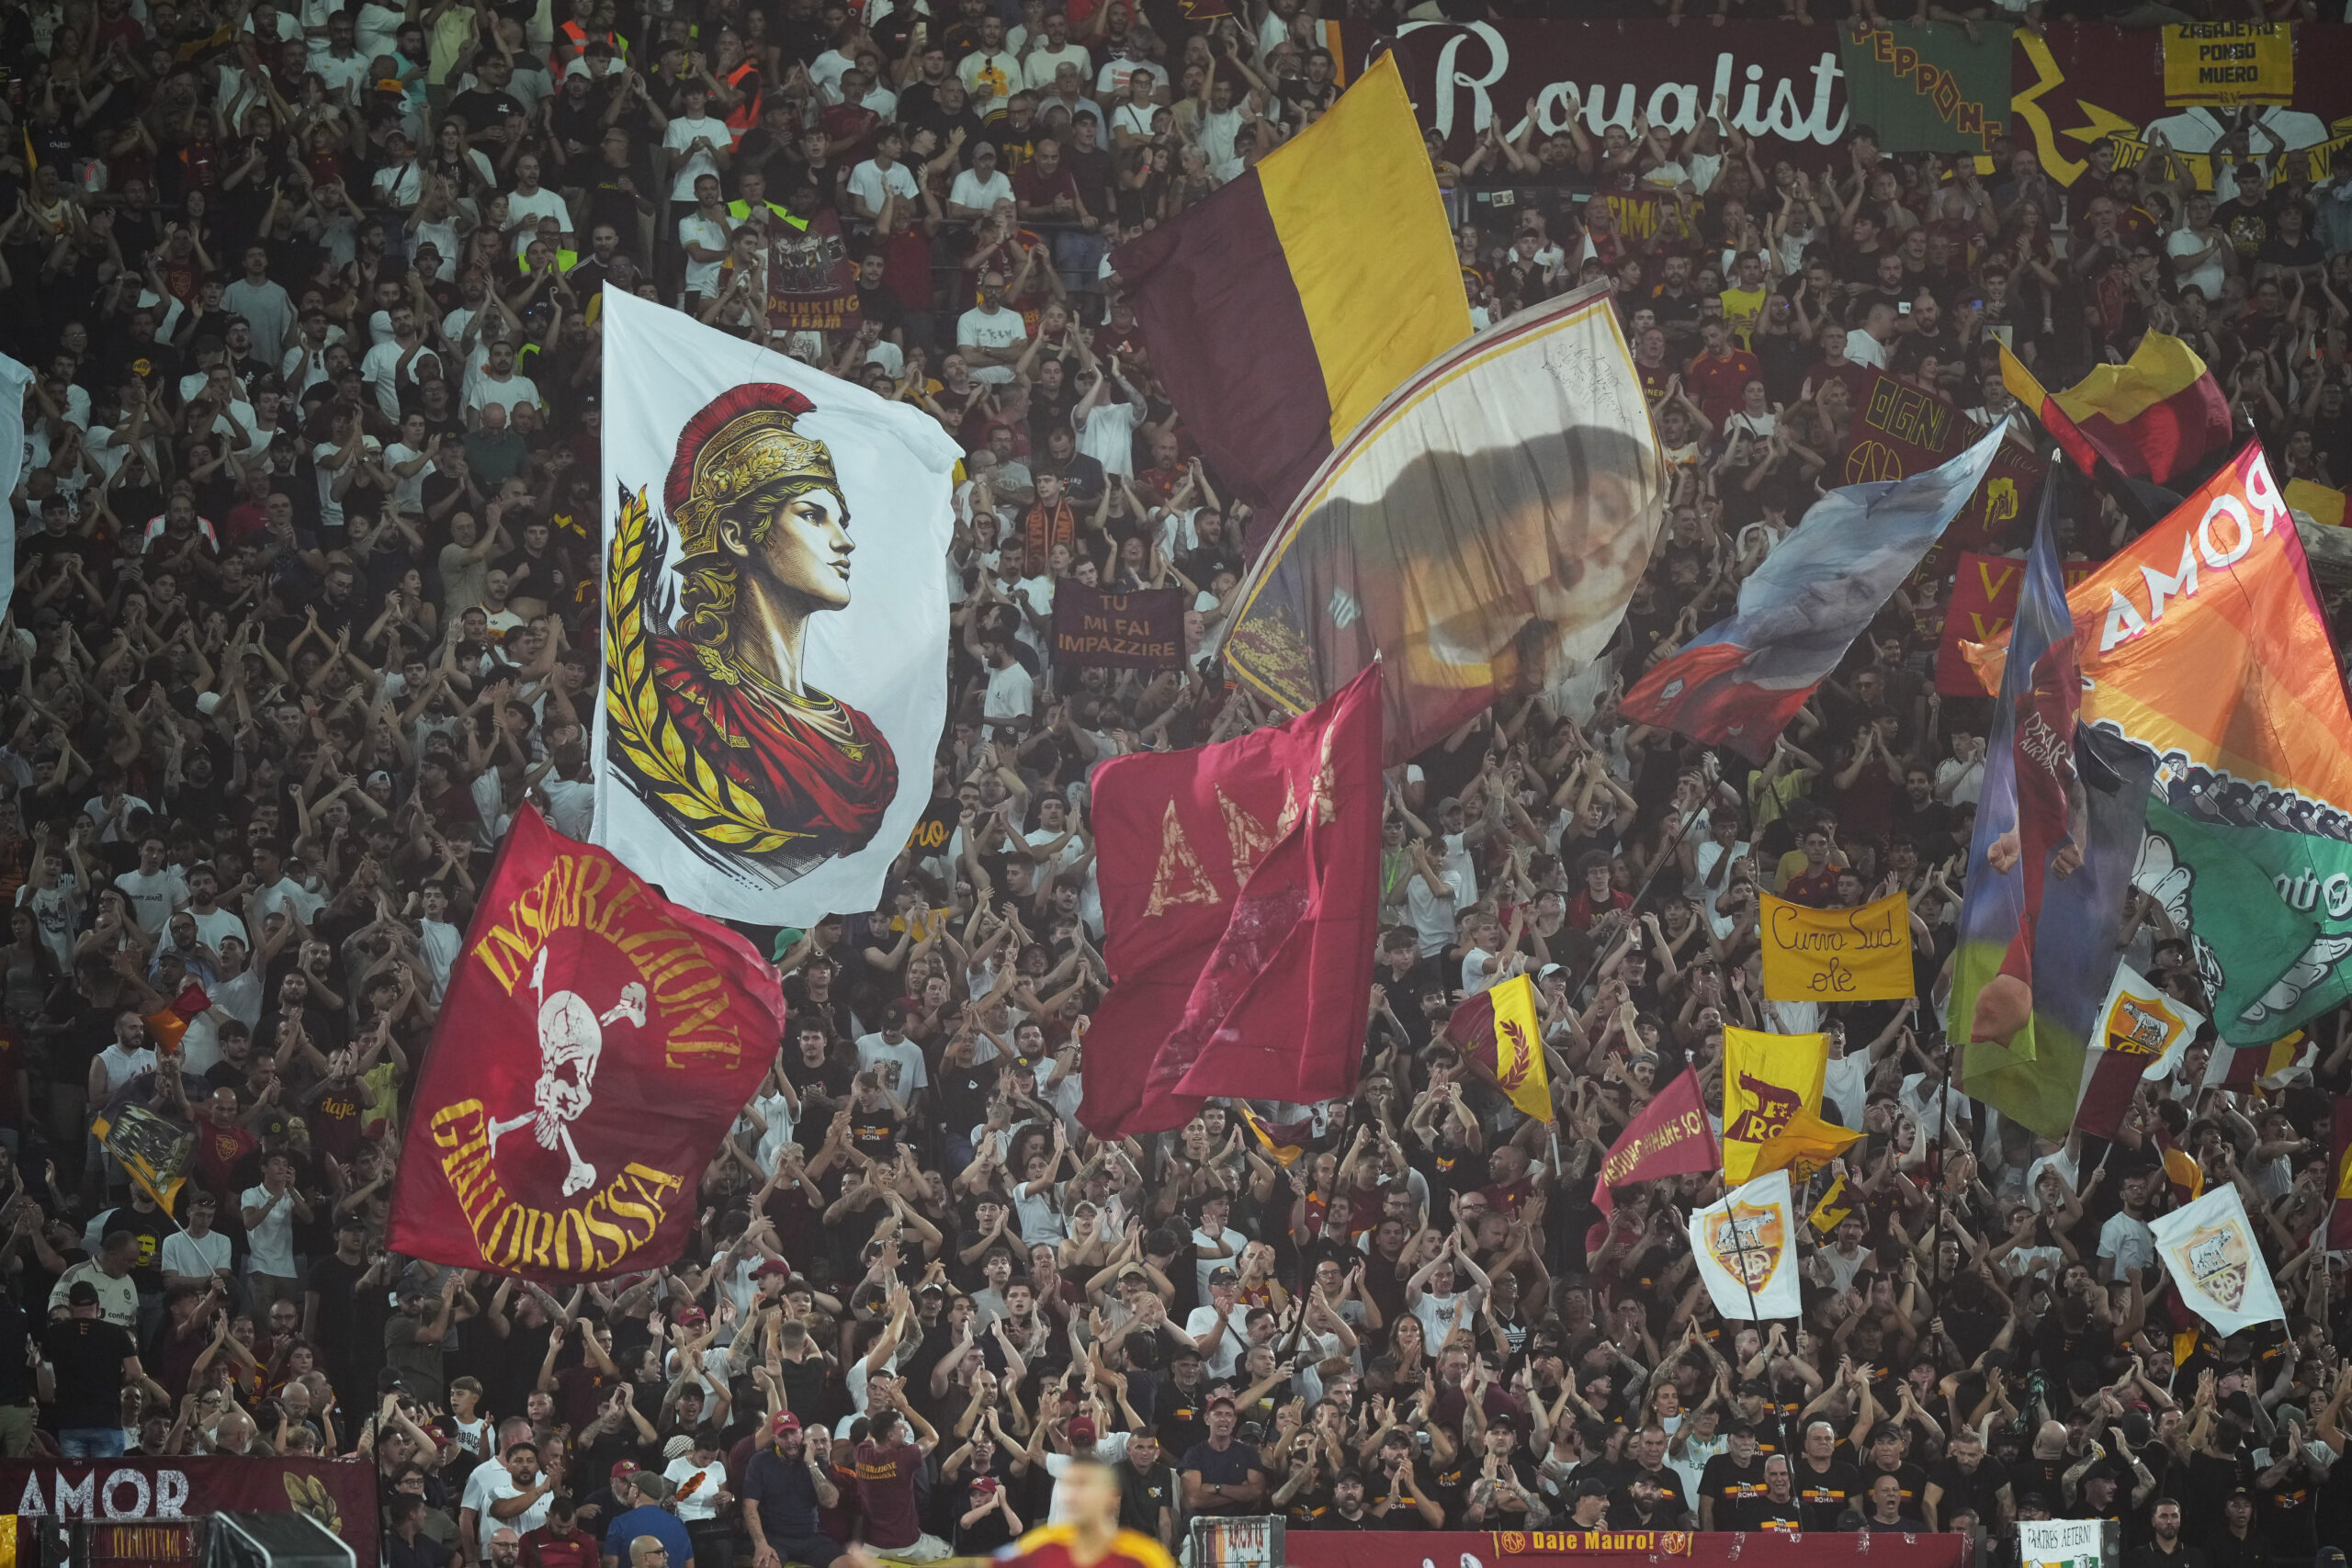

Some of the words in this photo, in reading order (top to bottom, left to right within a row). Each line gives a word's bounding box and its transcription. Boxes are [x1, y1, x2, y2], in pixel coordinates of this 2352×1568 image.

[2199, 43, 2256, 61] PONGO
[1852, 18, 2002, 152] PEPPONE
[2199, 65, 2258, 84] MUERO
[768, 295, 860, 313] DRINKING
[791, 314, 842, 329] TEAM
[1865, 376, 1954, 453] OGNI
[1100, 594, 1128, 611] TU
[1084, 615, 1108, 632] MI
[1115, 619, 1150, 637] FAI
[1058, 633, 1176, 656] IMPAZZIRE
[1772, 906, 1848, 951] Curva
[1849, 908, 1902, 950] Sud
[470, 854, 742, 1070] INSURREZIONE
[1807, 957, 1856, 992] olè
[322, 1098, 356, 1120] daje.
[430, 1098, 685, 1274] GIALLOROSSA
[17, 1467, 190, 1523] AMOR
[1532, 1531, 1577, 1551] Daje
[1585, 1531, 1655, 1550] Mauro!
[2062, 1525, 2091, 1548] AETERNI
